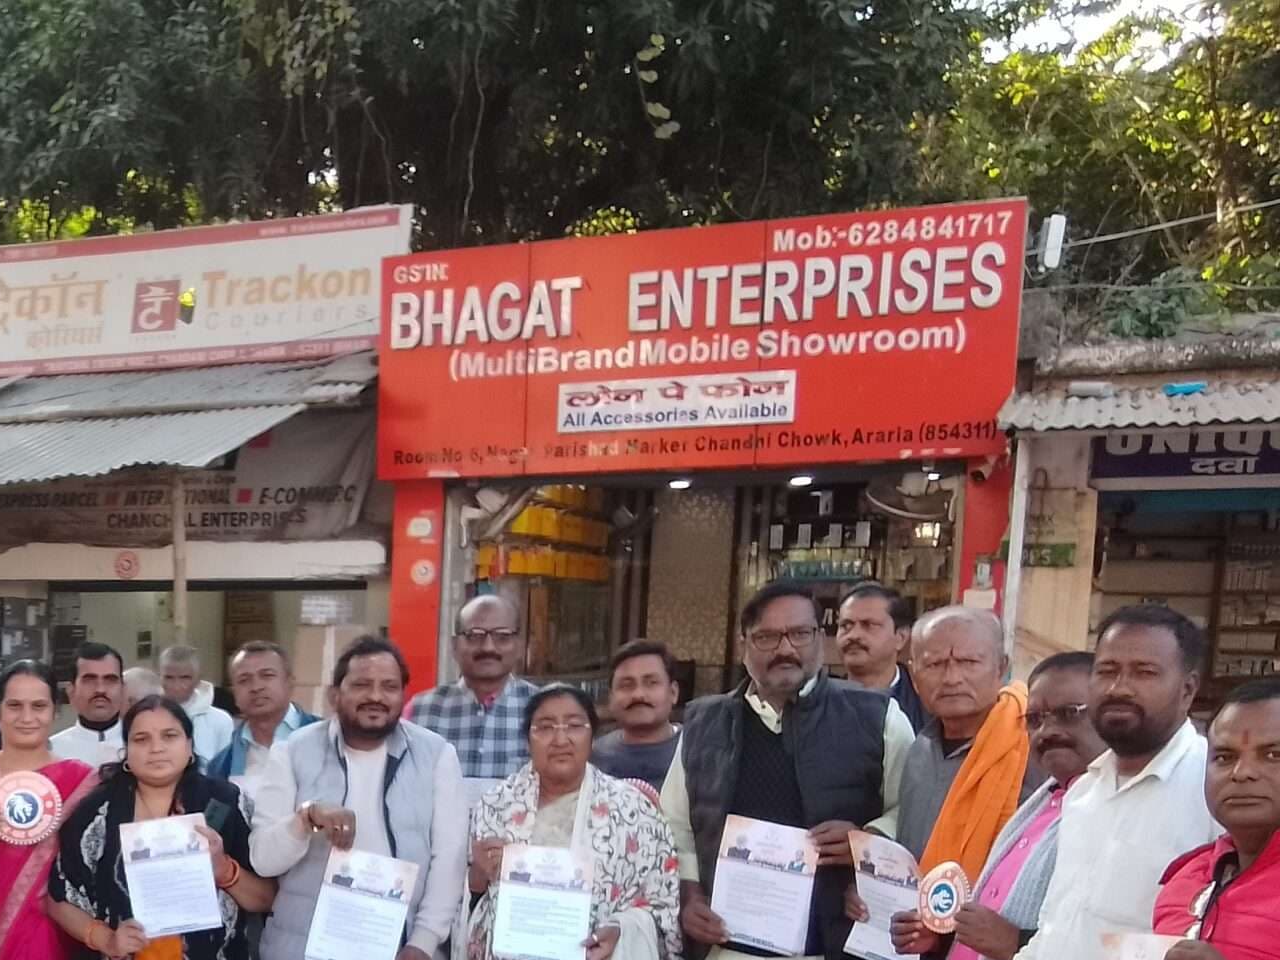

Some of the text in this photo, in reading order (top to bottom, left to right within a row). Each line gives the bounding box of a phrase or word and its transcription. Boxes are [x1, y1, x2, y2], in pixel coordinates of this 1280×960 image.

[202, 263, 373, 308] Trackon
[390, 241, 1006, 349] BHAGAT ENTERPRISES
[639, 333, 750, 367] Mobile
[757, 317, 966, 358] Showroom)
[563, 402, 788, 428] All Accessories Available
[919, 418, 998, 445] (854311)
[1190, 456, 1259, 474] दवा
